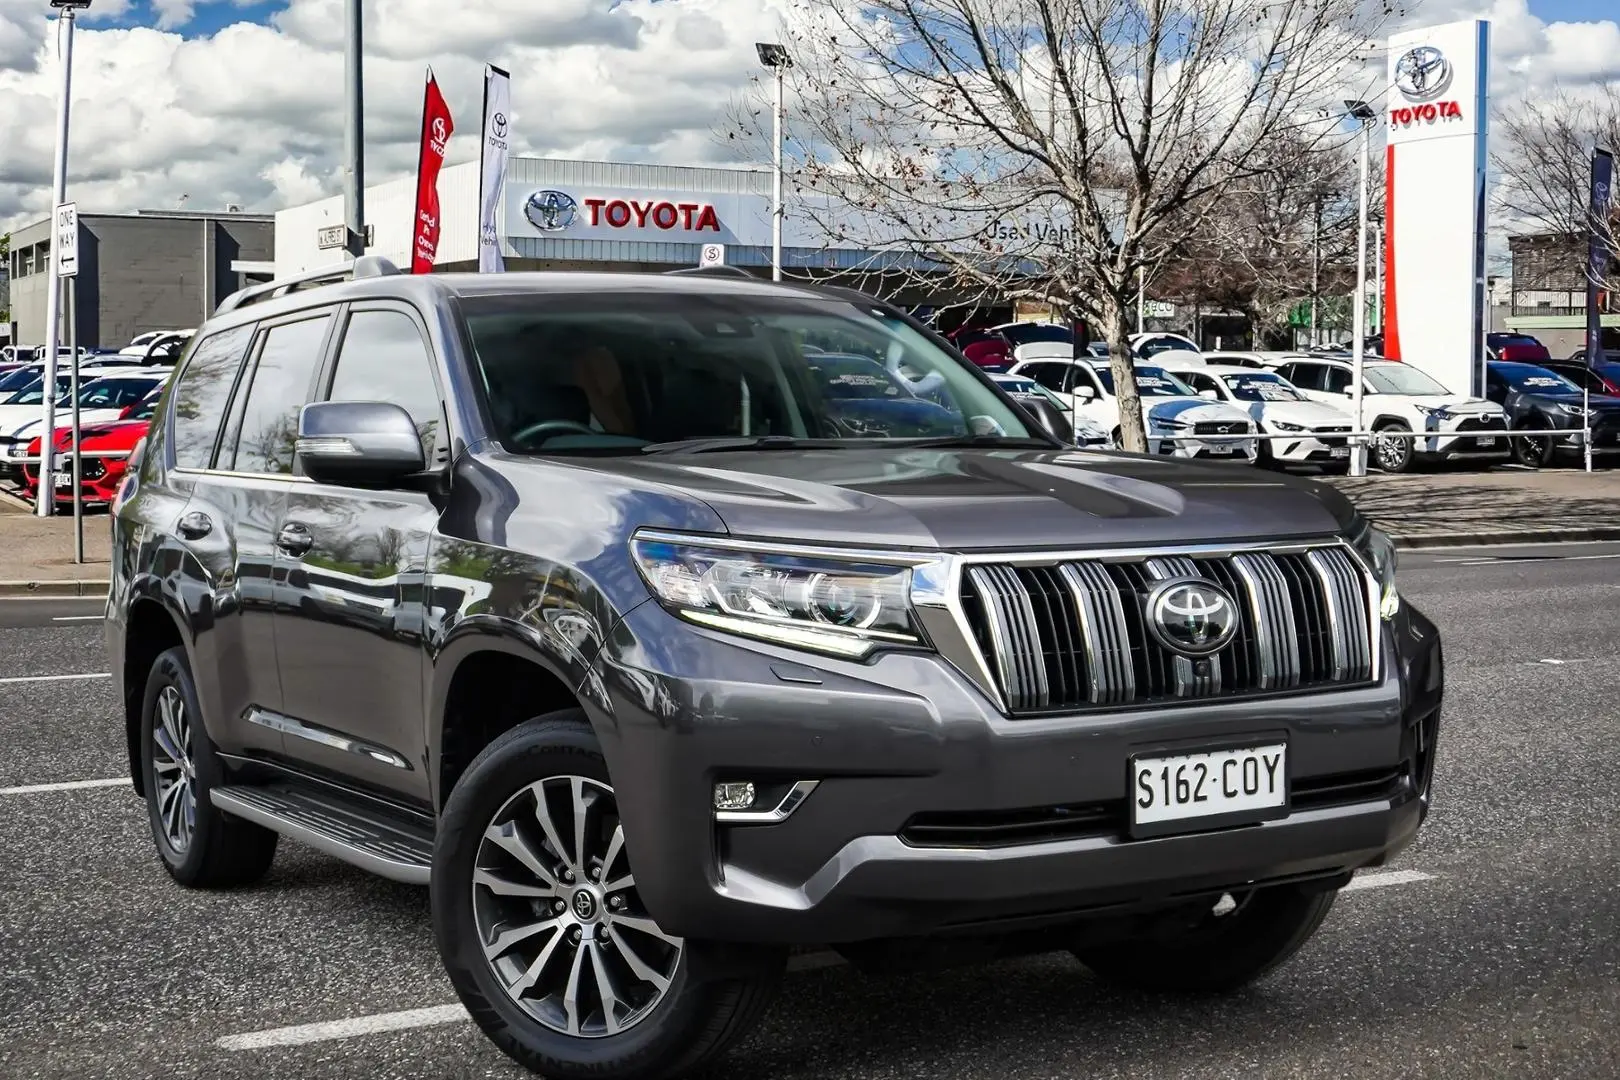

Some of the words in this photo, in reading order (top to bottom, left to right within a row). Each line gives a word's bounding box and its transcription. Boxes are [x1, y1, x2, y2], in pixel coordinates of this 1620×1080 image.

[1390, 101, 1462, 125] TOYOTA
[60, 209, 74, 227] ONE
[584, 199, 721, 232] TOYOTA
[985, 220, 1030, 239] Used
[60, 231, 75, 249] WAY
